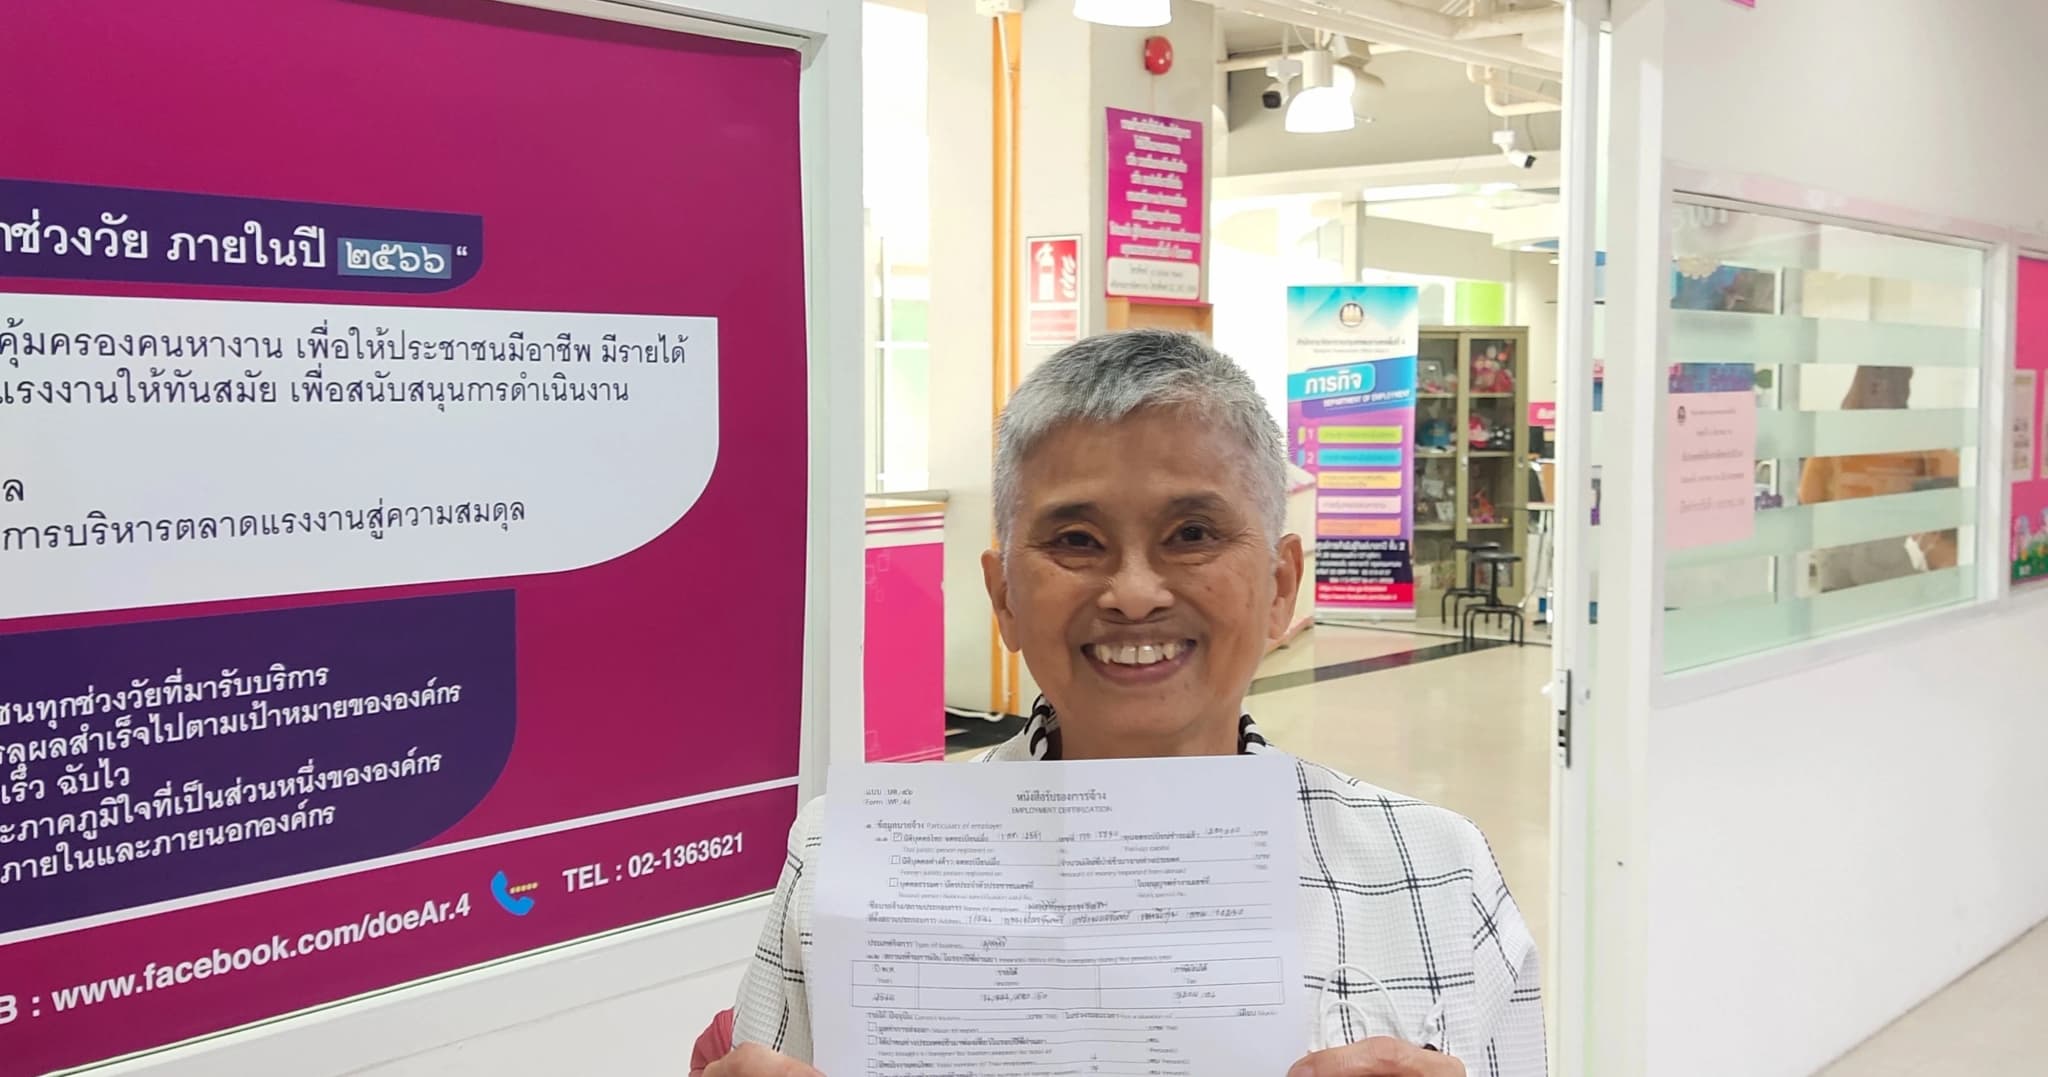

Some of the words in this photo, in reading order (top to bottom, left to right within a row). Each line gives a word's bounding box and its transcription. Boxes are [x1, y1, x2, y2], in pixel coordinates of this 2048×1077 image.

[166, 220, 326, 268] ภายในปี
[345, 241, 445, 274] ๒๕๖๖
[0, 317, 283, 368] คุ้มครองคนหางาน
[297, 319, 592, 363] เพื่อให้ประชาชนมีอาชีพ
[601, 332, 689, 364] มีรายได้
[291, 363, 629, 412] เพื่อสนับสนุนการดำเนินงาน
[1305, 369, 1362, 395] ภารกิจ
[3, 497, 526, 550] การบริหารตลาดแรงงานสู่ความสมดุล
[56, 757, 130, 796] ฉับไว
[0, 799, 337, 884] ภายในและภายนอกองค์กร
[562, 863, 609, 893] TEL
[627, 831, 744, 878] 02-1363621
[51, 892, 472, 1013] www.facebook.com/doeAr.4
